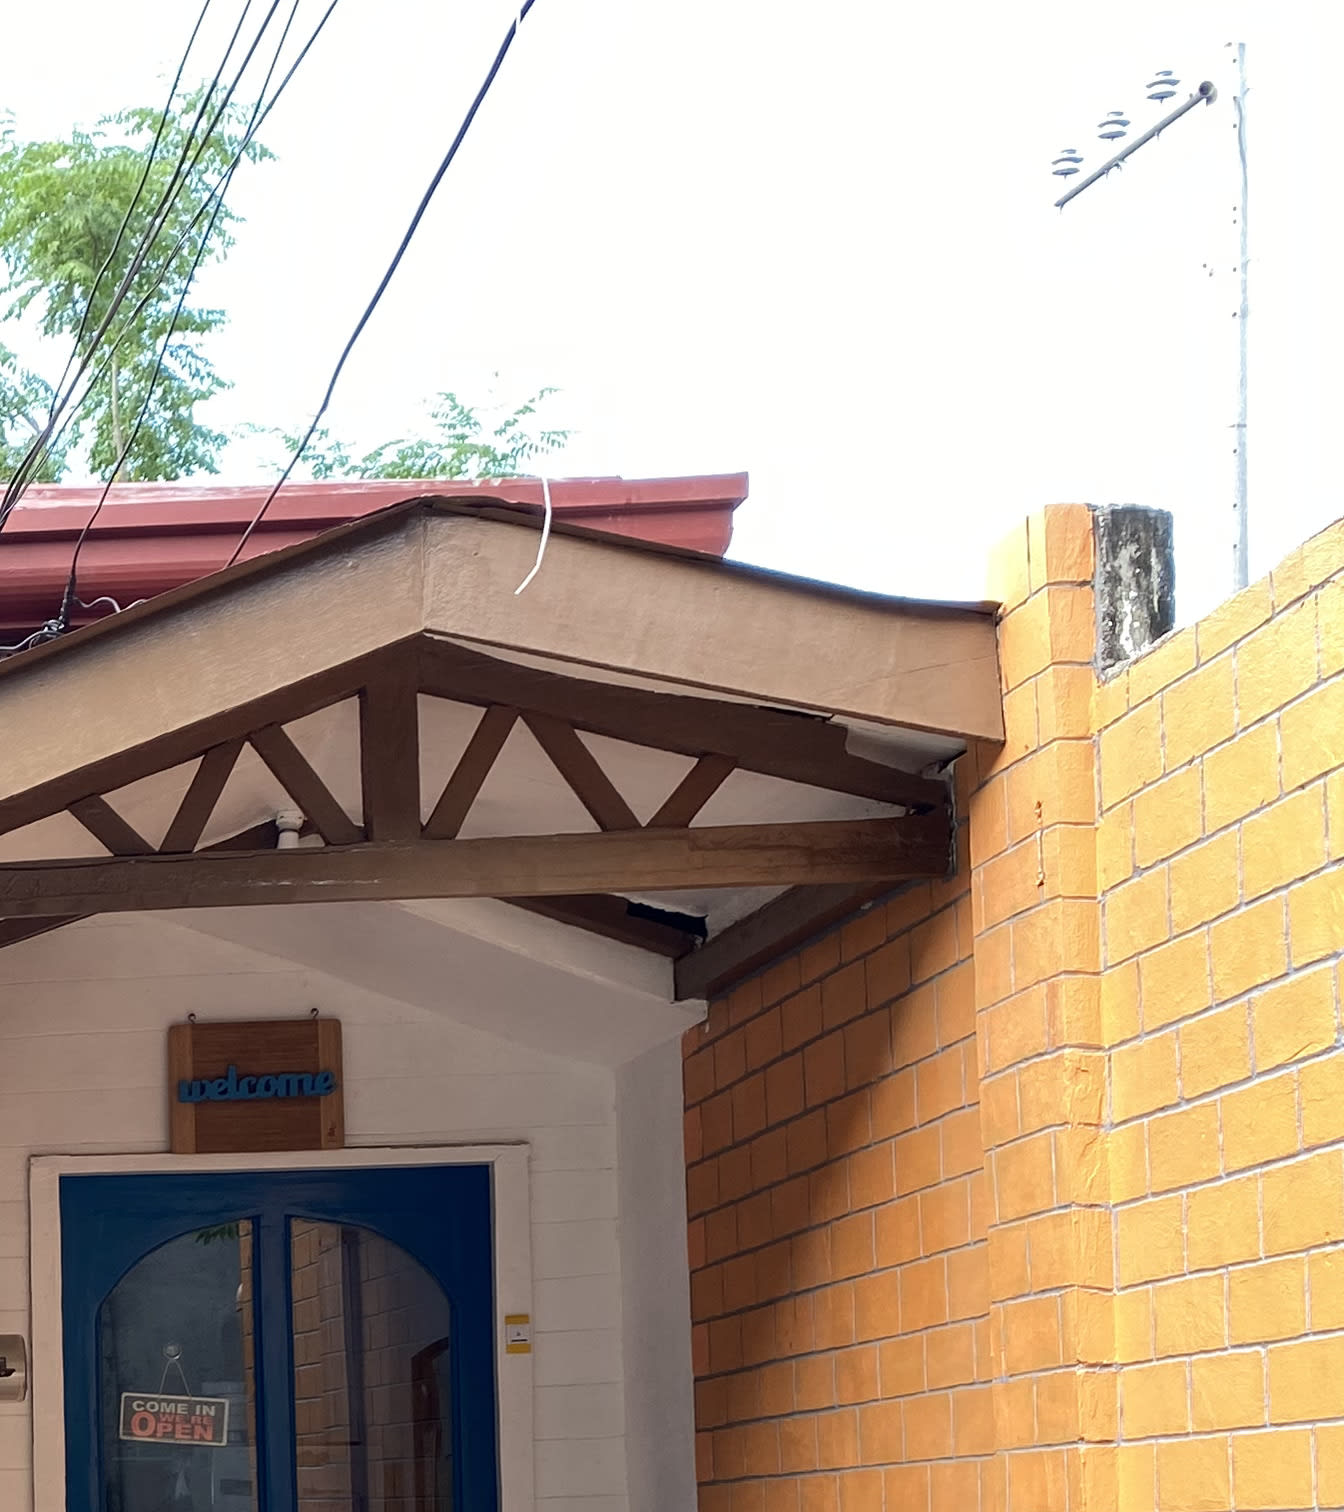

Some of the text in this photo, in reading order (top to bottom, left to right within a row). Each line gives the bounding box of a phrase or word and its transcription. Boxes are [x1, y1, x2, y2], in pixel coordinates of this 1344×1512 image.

[178, 1063, 335, 1103] welcome
[132, 1401, 216, 1416] COME IN
[130, 1411, 213, 1441] OPEN
